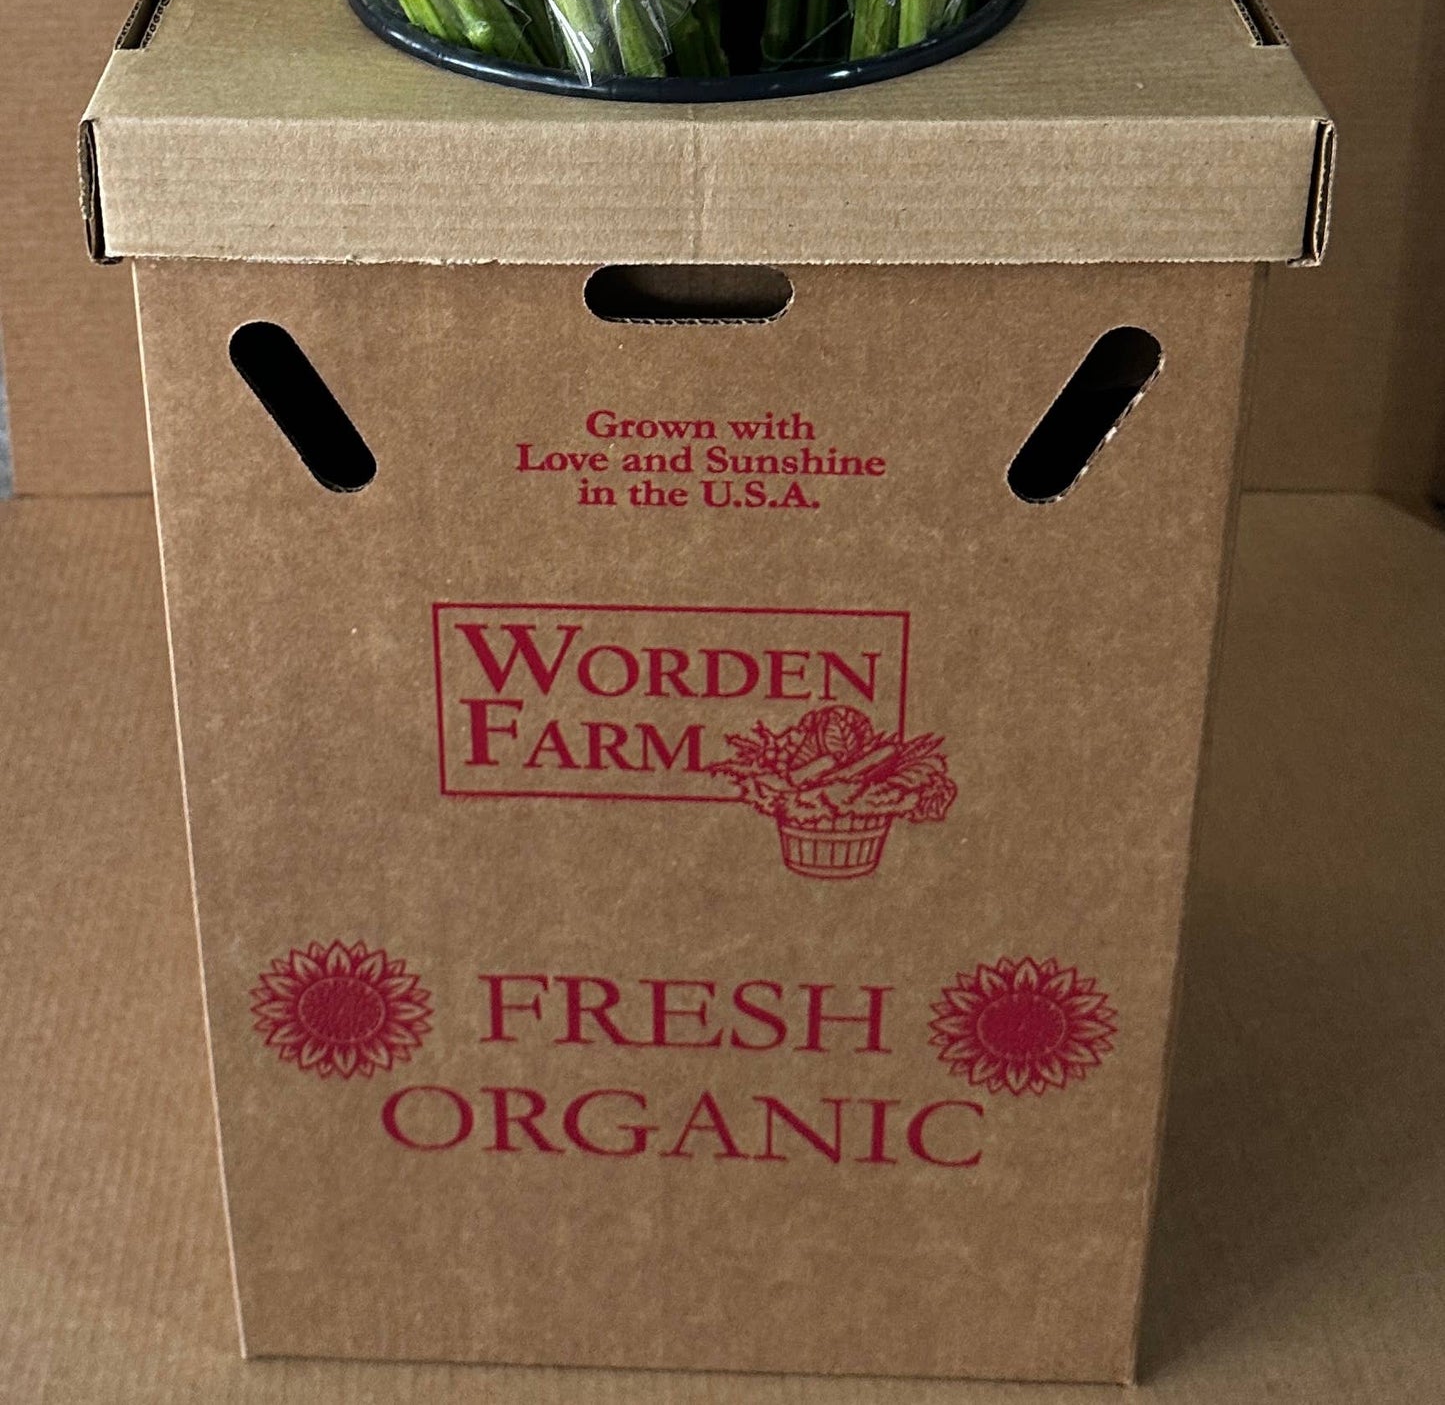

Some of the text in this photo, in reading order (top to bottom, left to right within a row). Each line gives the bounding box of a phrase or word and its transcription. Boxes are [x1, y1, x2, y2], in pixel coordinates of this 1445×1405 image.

[516, 443, 886, 477] Love and Sunshine
[585, 409, 815, 441] Grown with
[577, 478, 820, 510] in the U.S.A.
[454, 623, 882, 703] WORDEN
[458, 698, 706, 772] FARM
[478, 973, 893, 1054] FRESH
[381, 1084, 986, 1168] ORGANIC
